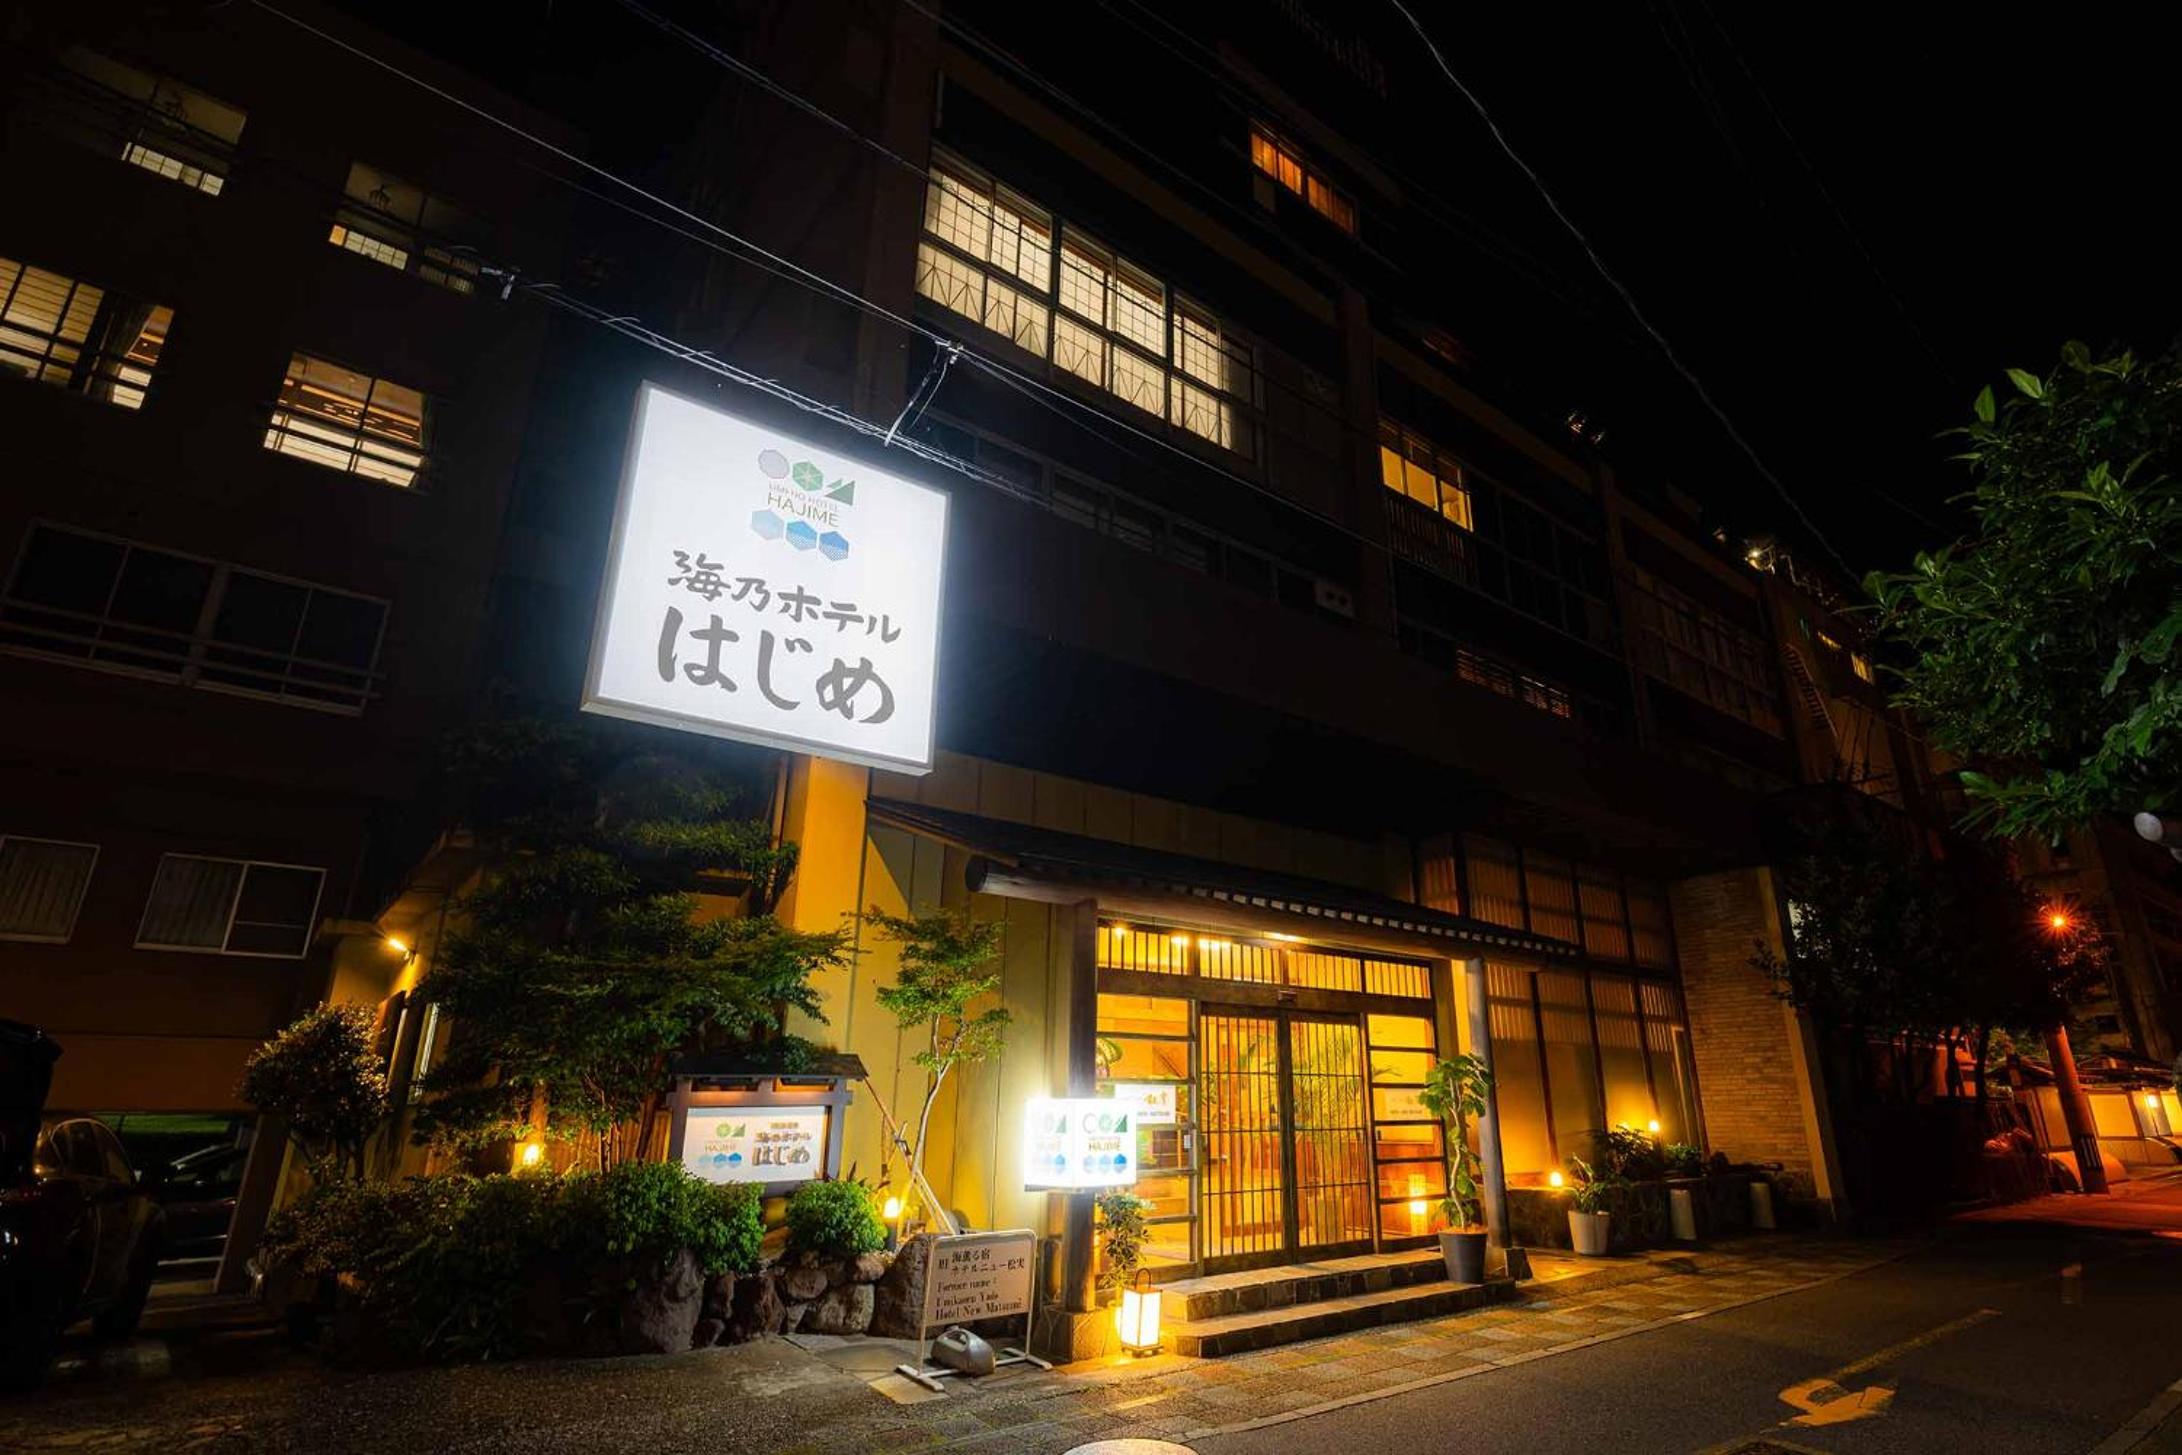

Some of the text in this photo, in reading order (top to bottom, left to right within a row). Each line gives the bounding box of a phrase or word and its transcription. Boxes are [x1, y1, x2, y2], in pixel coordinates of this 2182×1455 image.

[767, 491, 840, 528] HAJIME
[667, 549, 901, 643] 海乃ホテル
[657, 606, 895, 724] はじめ
[751, 1144, 811, 1166] はじめ
[936, 1306, 960, 1320] Hotel
[963, 1304, 981, 1318] New
